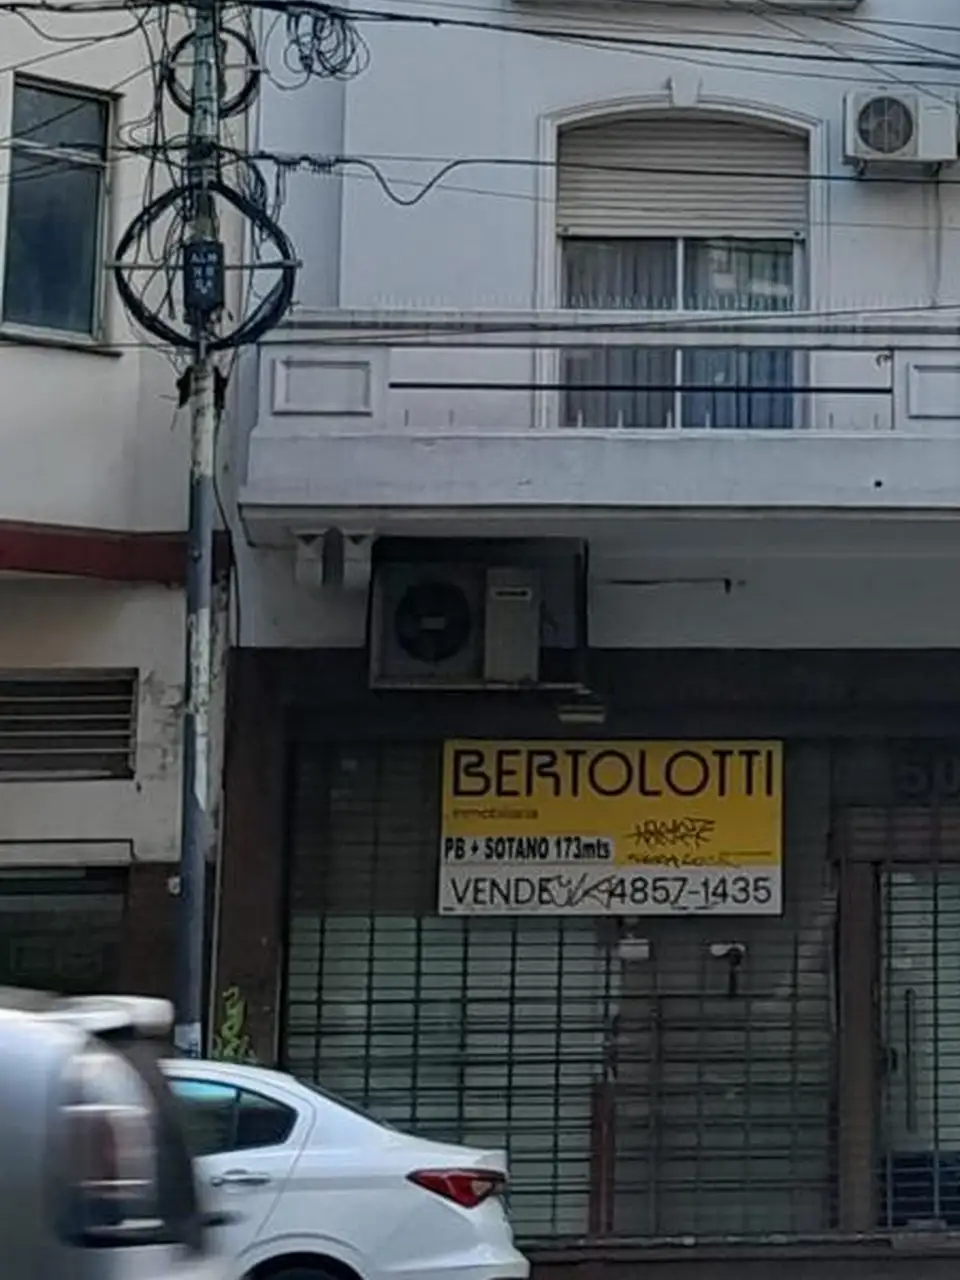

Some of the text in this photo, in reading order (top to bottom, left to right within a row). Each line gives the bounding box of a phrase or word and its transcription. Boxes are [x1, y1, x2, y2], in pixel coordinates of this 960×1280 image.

[452, 749, 774, 798] BERTOLOTTI
[444, 836, 466, 859] PB
[484, 836, 550, 860] SOTANO
[554, 835, 613, 860] 173mts
[450, 877, 554, 906] VENDE
[608, 875, 773, 906] 4857-1435
